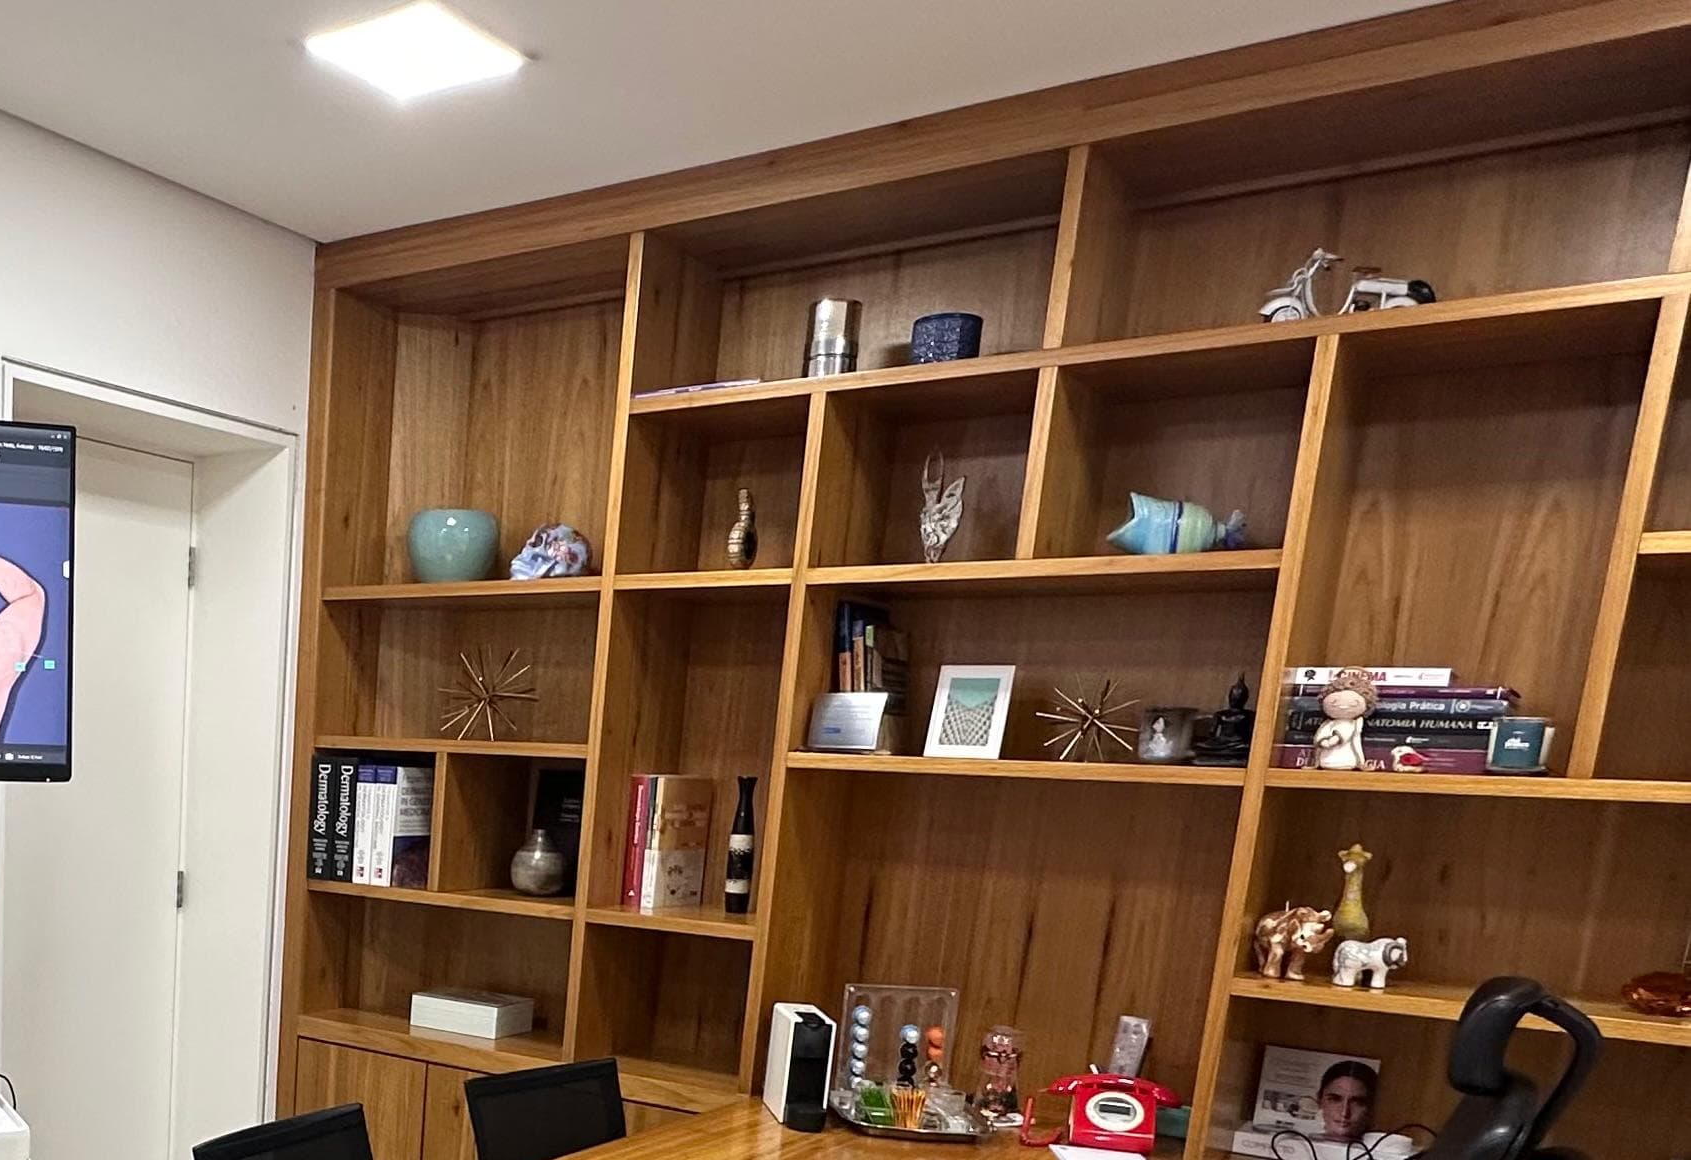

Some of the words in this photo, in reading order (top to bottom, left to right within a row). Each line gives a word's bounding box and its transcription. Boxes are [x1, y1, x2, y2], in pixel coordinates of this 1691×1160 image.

[1366, 718, 1417, 729] NATOMIA
[1419, 719, 1473, 730] HUMANA
[1409, 701, 1446, 711] Prática
[313, 763, 332, 835] Dermatology
[334, 765, 354, 838] Dermatology
